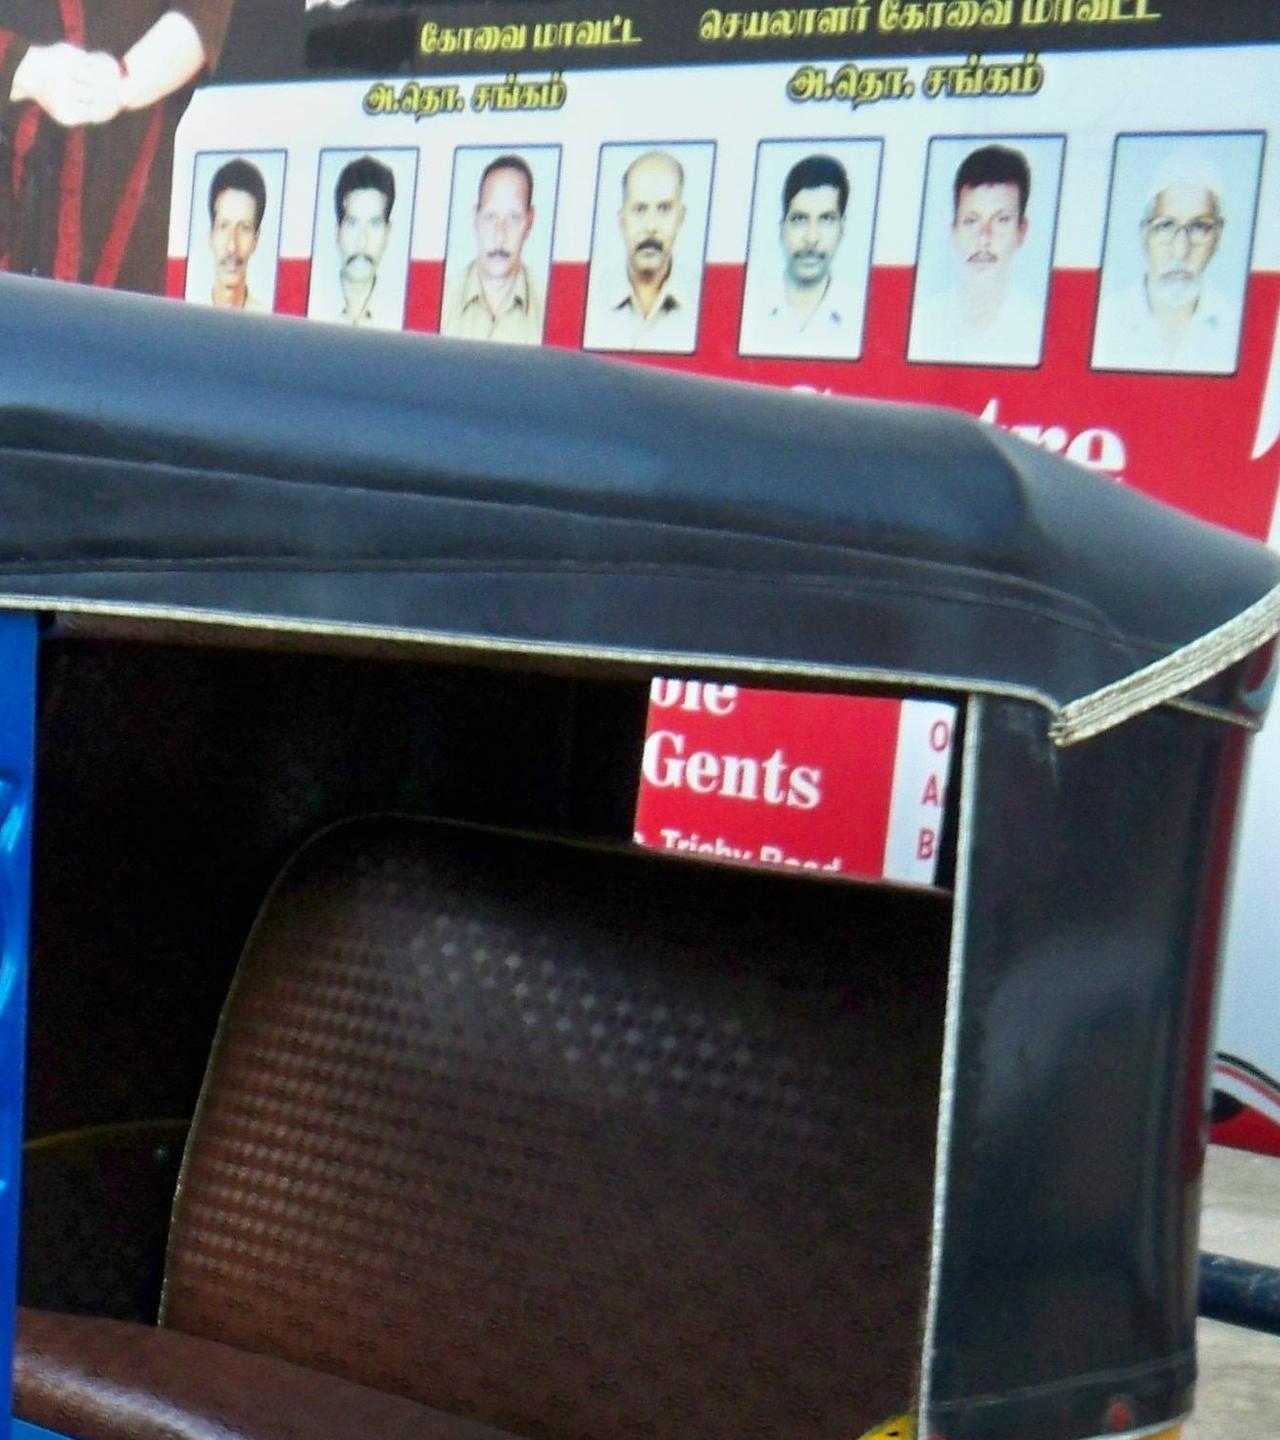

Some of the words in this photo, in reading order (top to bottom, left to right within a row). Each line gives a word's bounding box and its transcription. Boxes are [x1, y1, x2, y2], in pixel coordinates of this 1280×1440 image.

[420, 22, 527, 54] கோவை
[533, 15, 643, 49] மாவட்ட
[470, 71, 567, 112] சங்கம்
[922, 51, 1044, 98] சங்கம்
[641, 729, 823, 810] Gents
